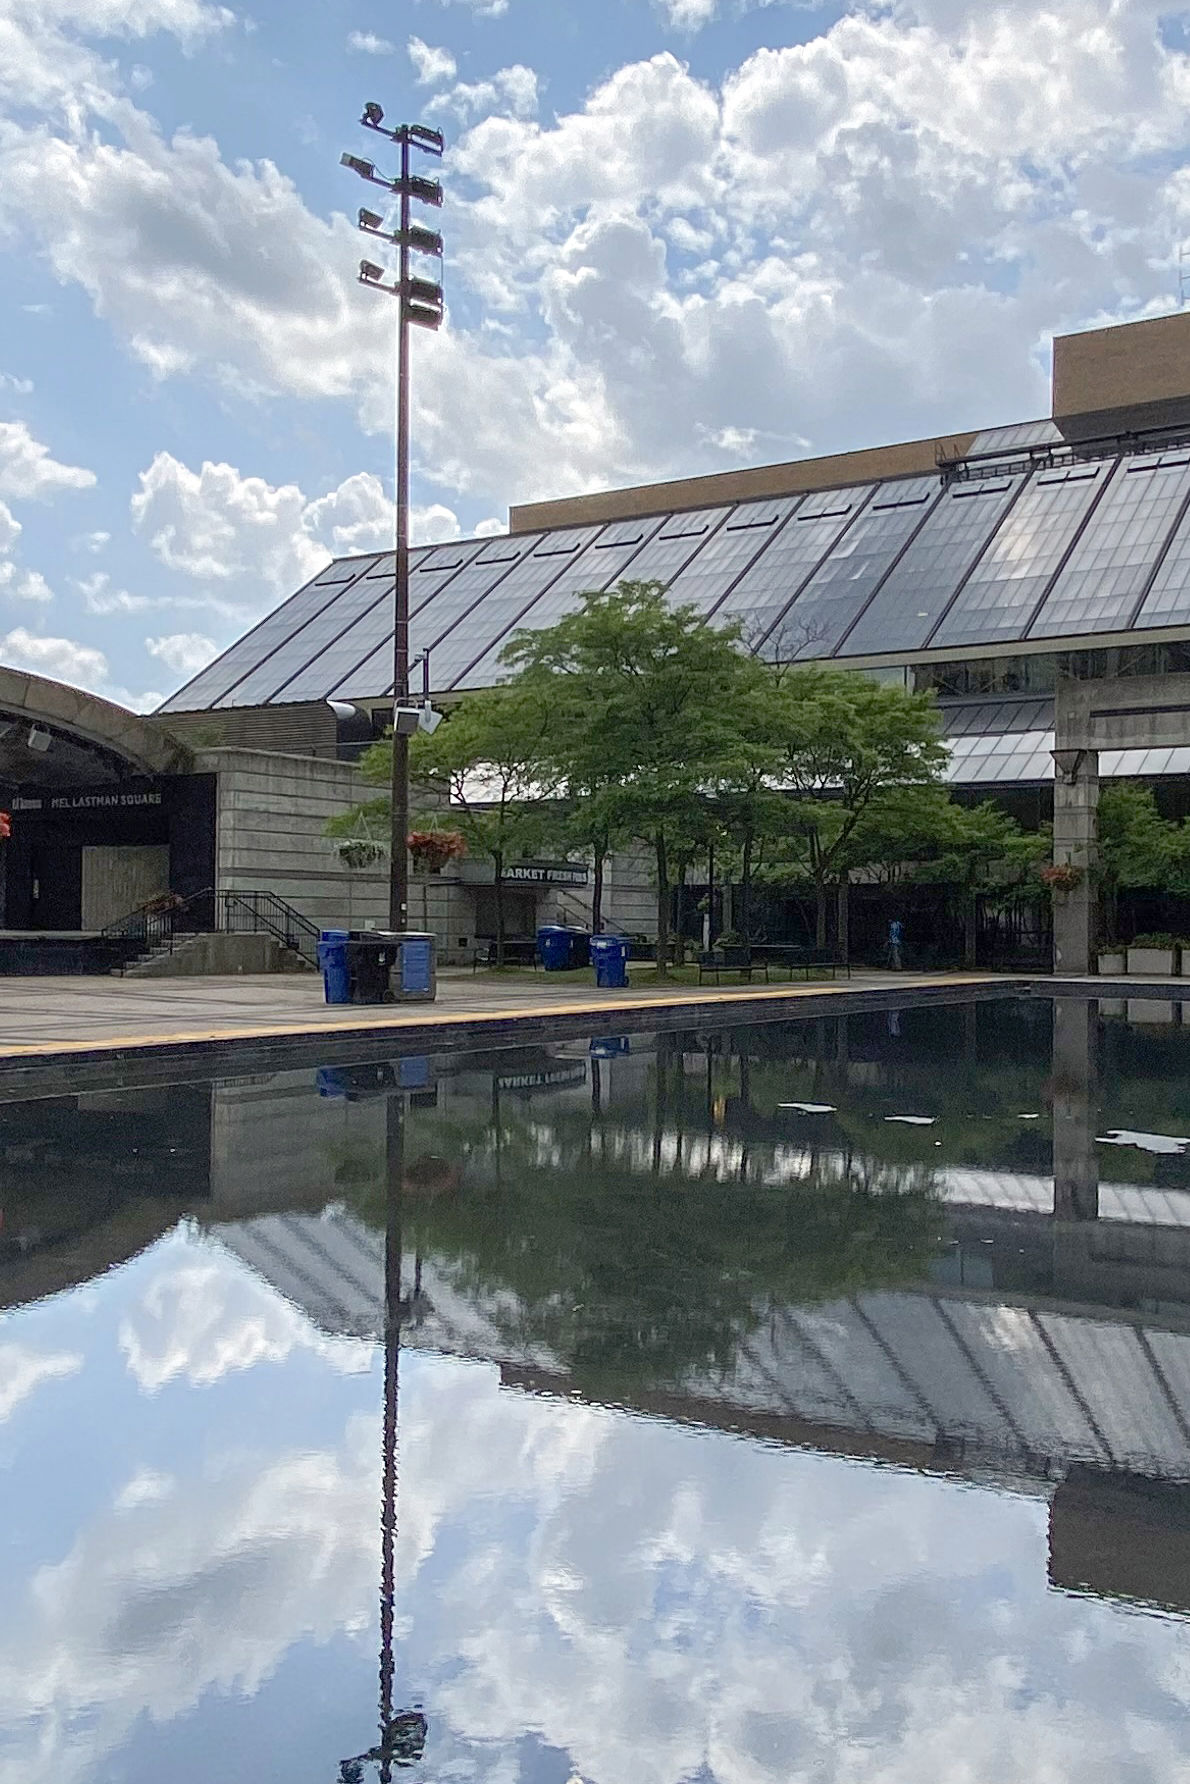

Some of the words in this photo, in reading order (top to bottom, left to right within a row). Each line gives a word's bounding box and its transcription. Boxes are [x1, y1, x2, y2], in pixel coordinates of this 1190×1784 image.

[51, 798, 70, 808] MEL
[73, 795, 119, 807] LASTMAN
[121, 793, 162, 805] SQUARE
